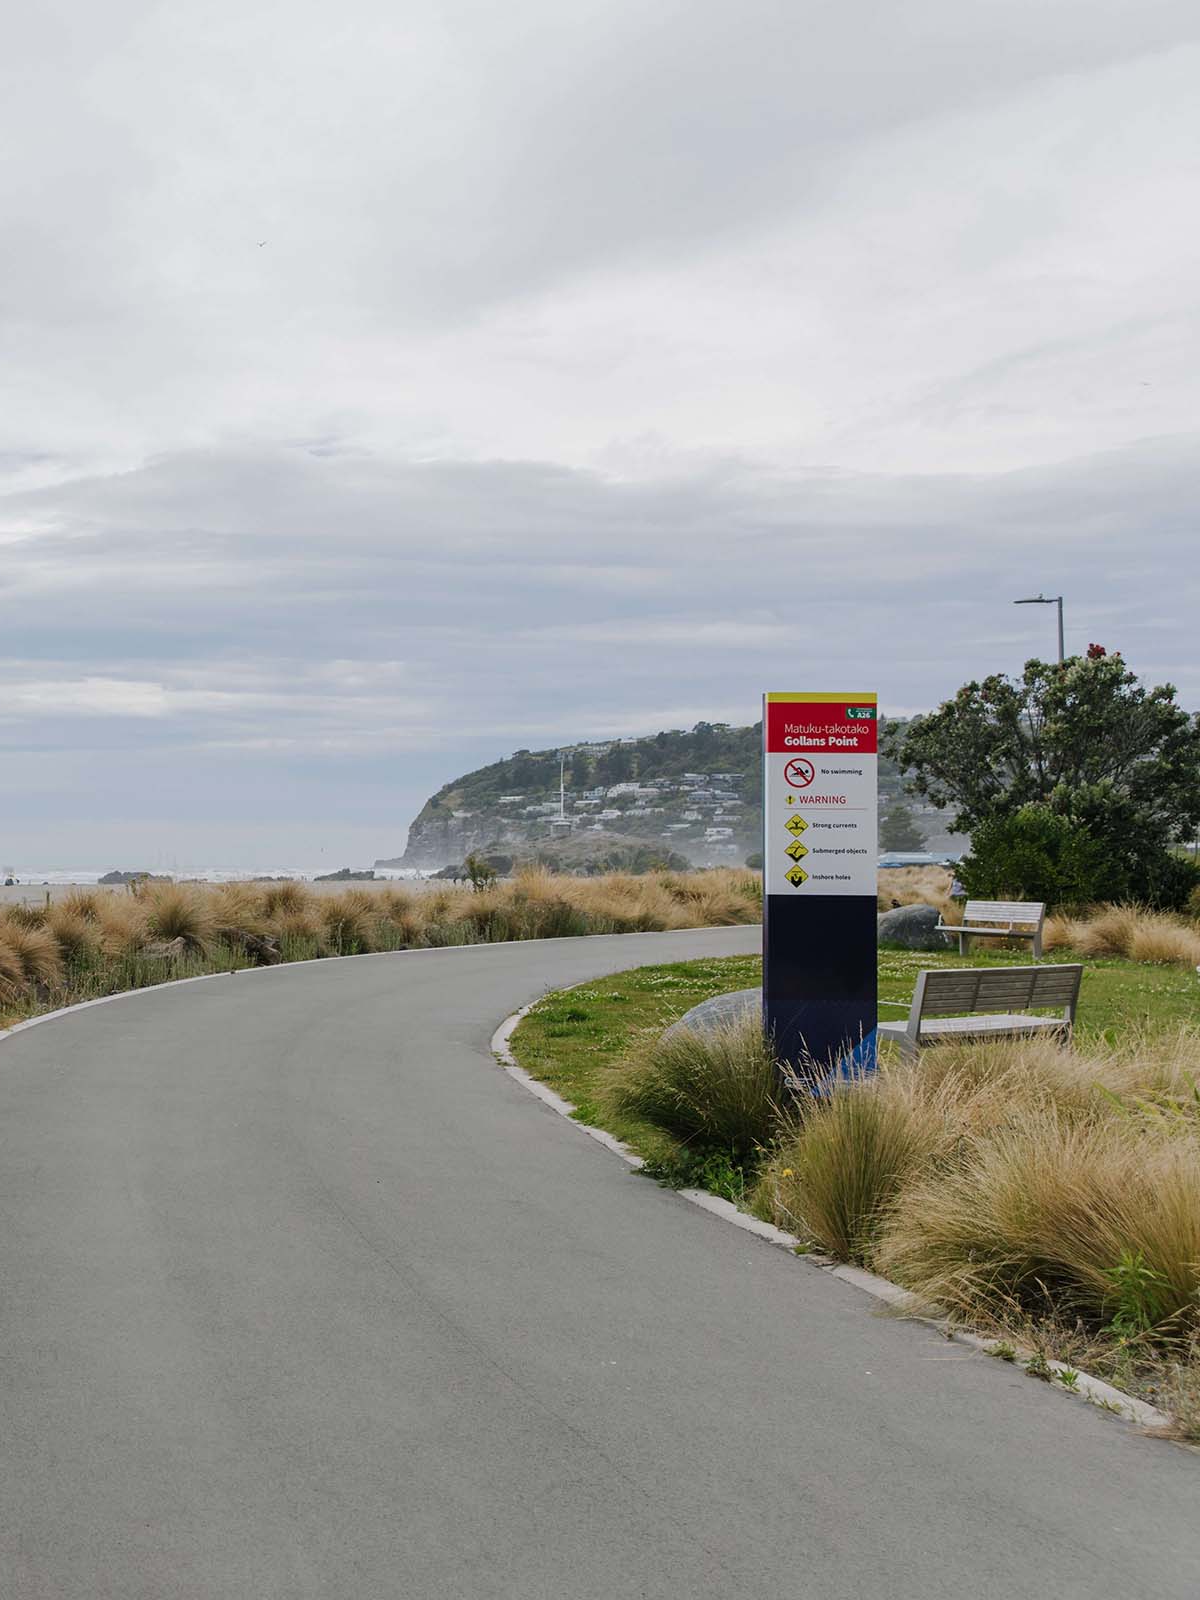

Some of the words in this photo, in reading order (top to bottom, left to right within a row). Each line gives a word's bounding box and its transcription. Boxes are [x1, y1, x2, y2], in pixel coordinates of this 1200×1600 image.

[784, 723, 869, 734] Matuku-takotako
[784, 736, 826, 746] Gollans
[828, 736, 858, 746] Point
[799, 795, 847, 804] WARNING
